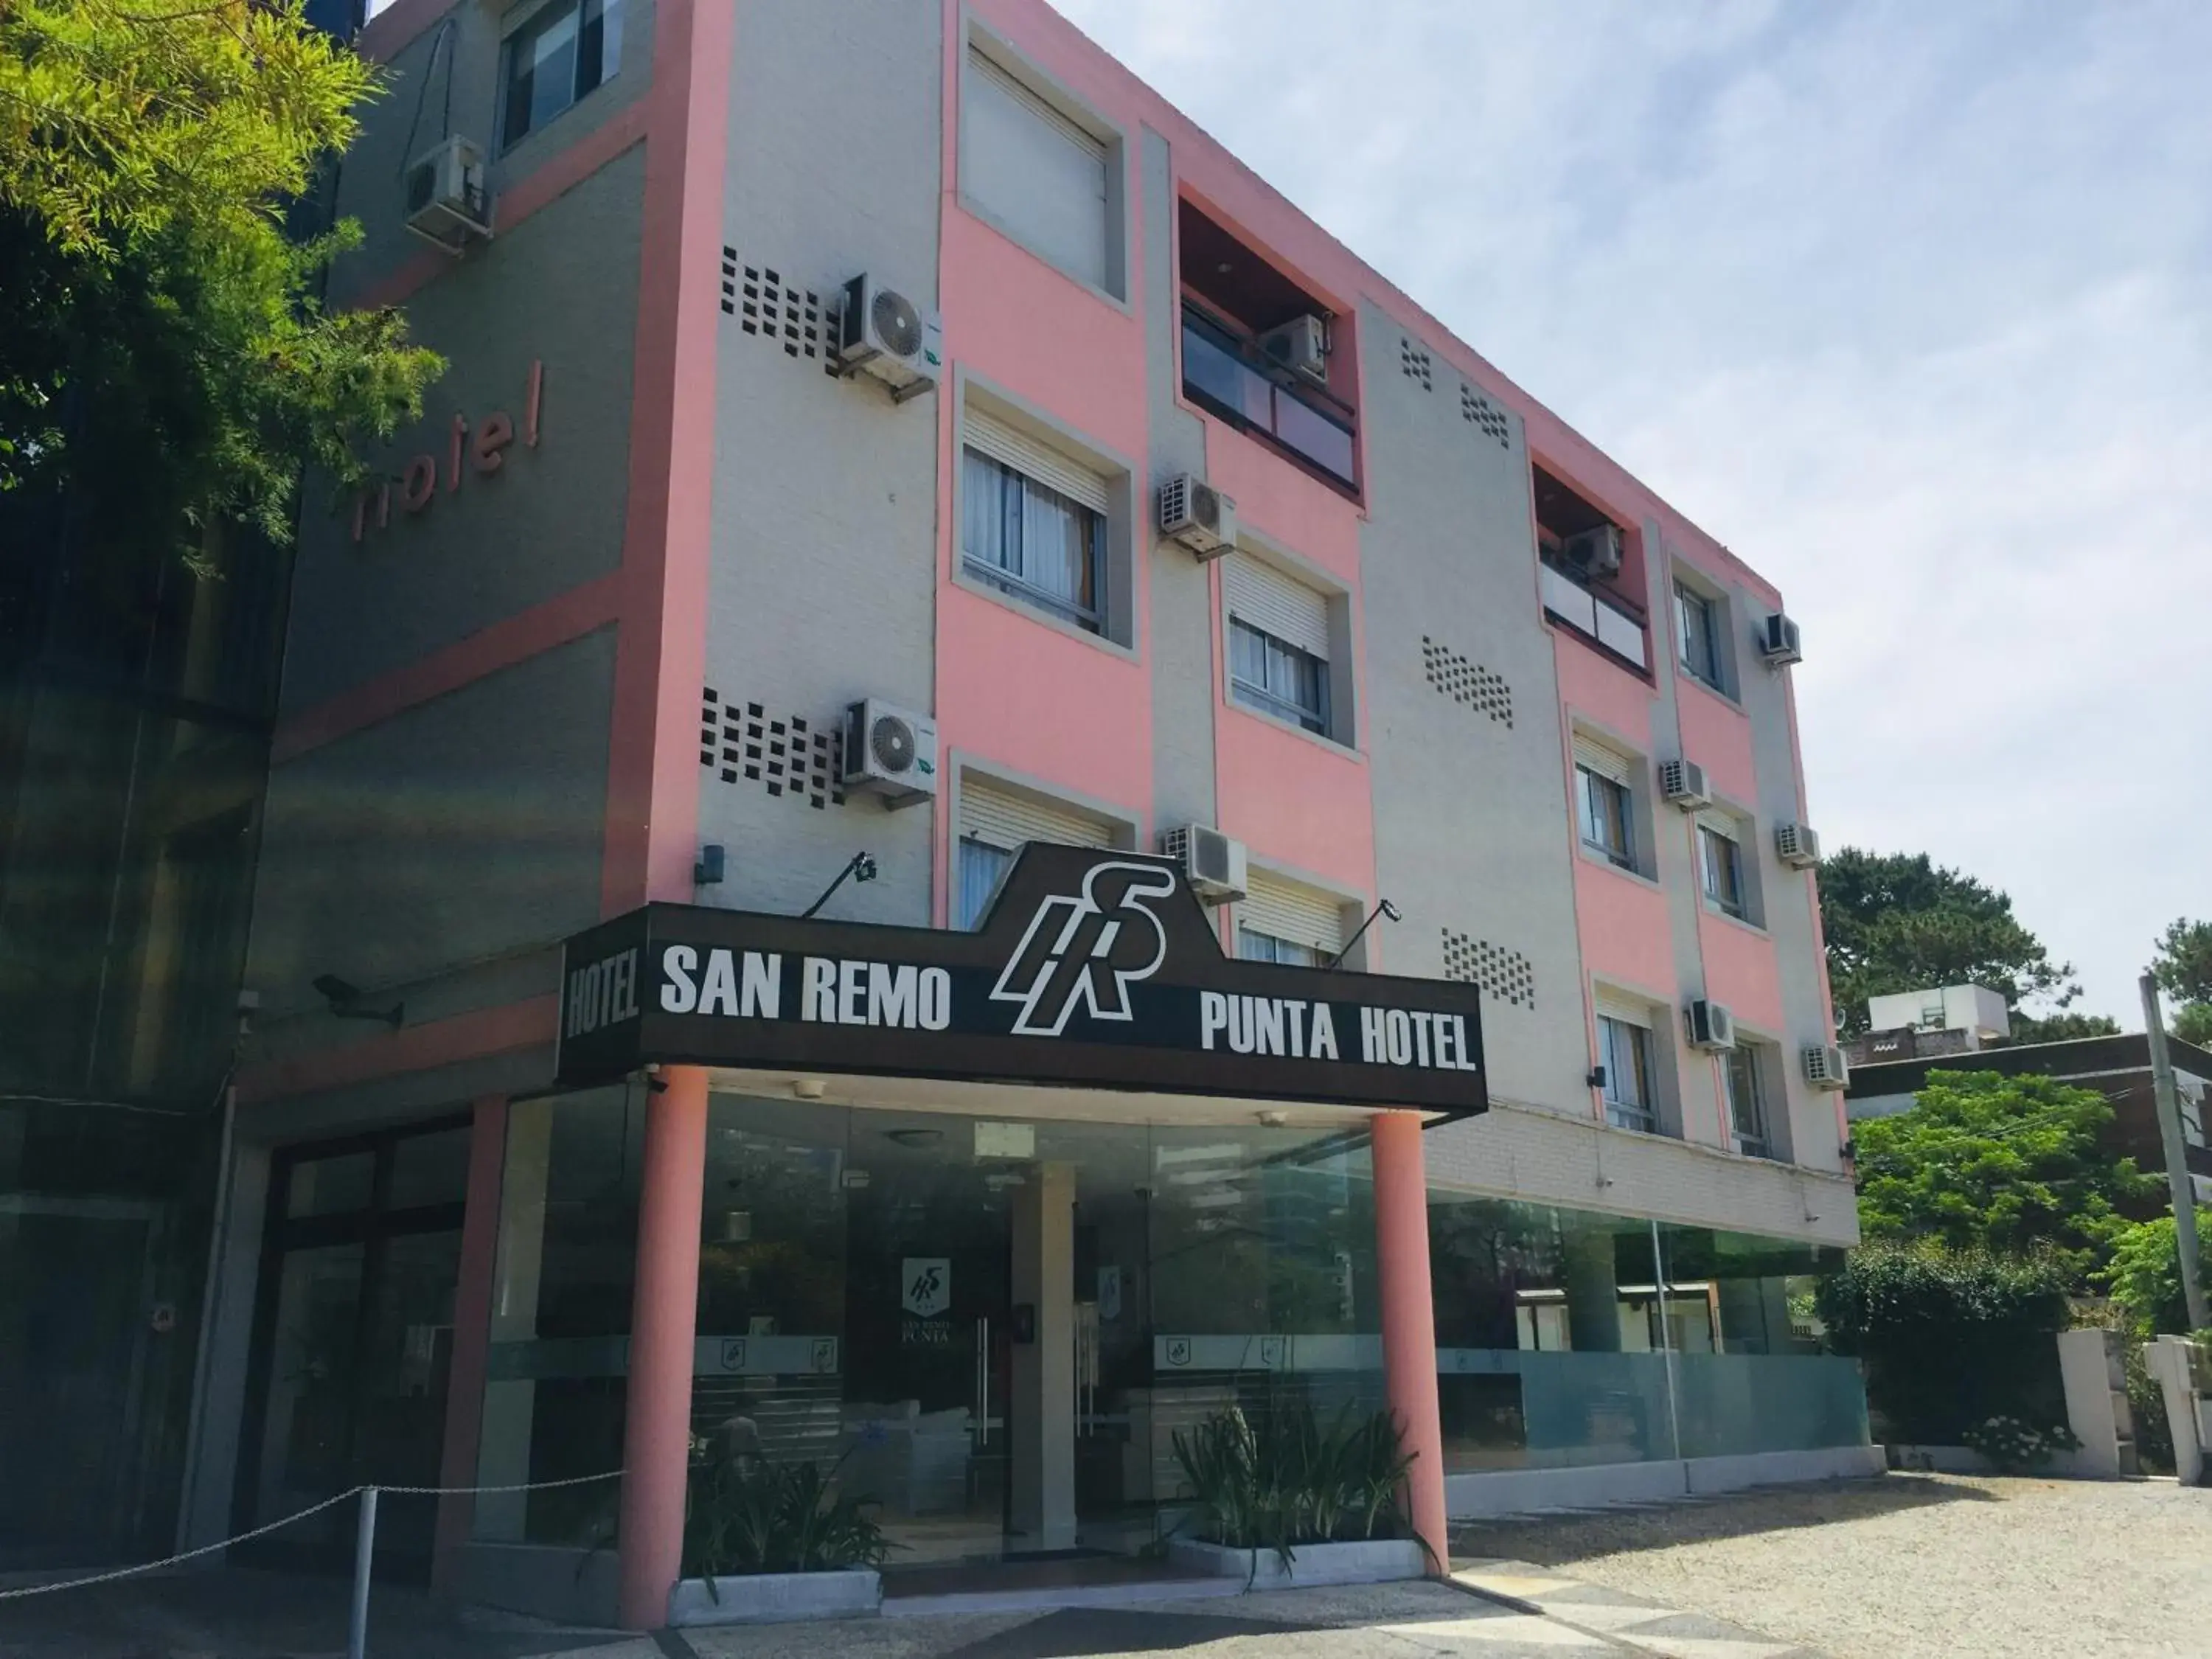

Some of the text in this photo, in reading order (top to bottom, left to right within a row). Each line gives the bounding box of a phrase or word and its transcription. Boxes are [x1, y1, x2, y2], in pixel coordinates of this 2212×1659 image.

[567, 947, 639, 1038] HOTEL
[660, 945, 1476, 1071] SAN REMO PUNTA HOTEL
